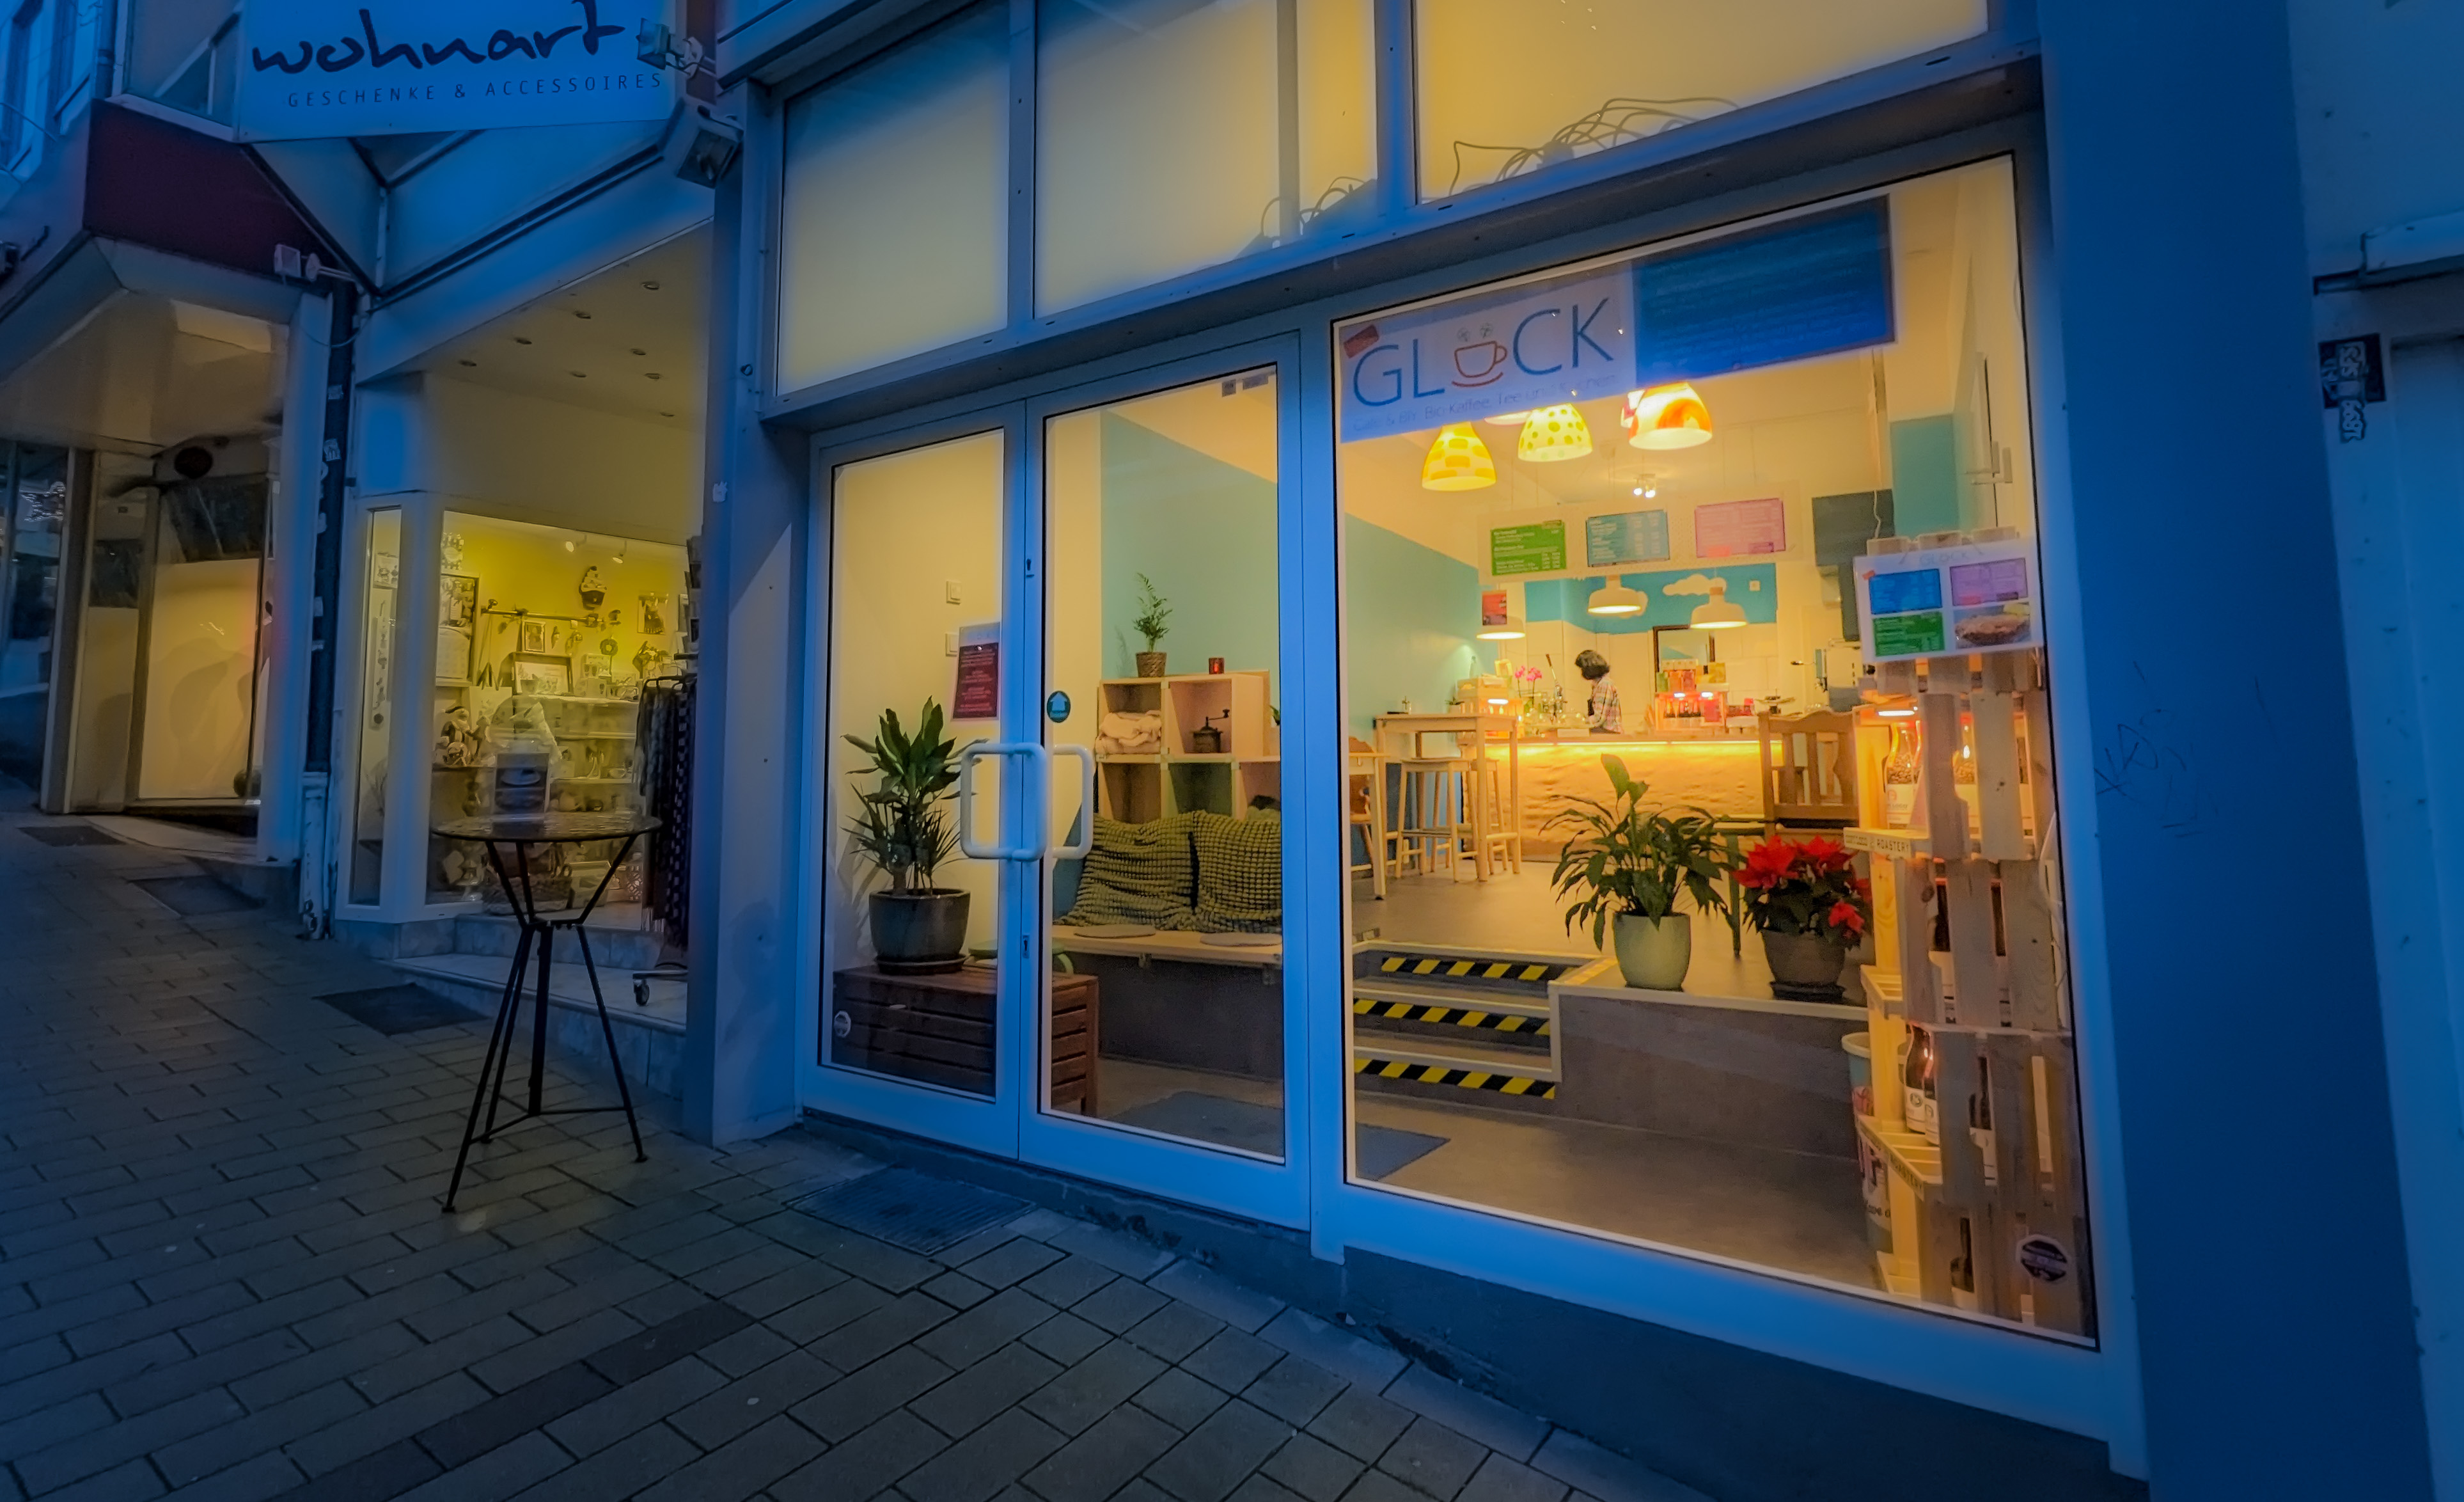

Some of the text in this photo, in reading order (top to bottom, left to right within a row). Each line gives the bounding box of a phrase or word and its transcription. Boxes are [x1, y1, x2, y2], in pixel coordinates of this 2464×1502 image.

[252, 0, 626, 74] wohnart
[288, 72, 661, 107] GESCHENKE & ACCESSOIRES
